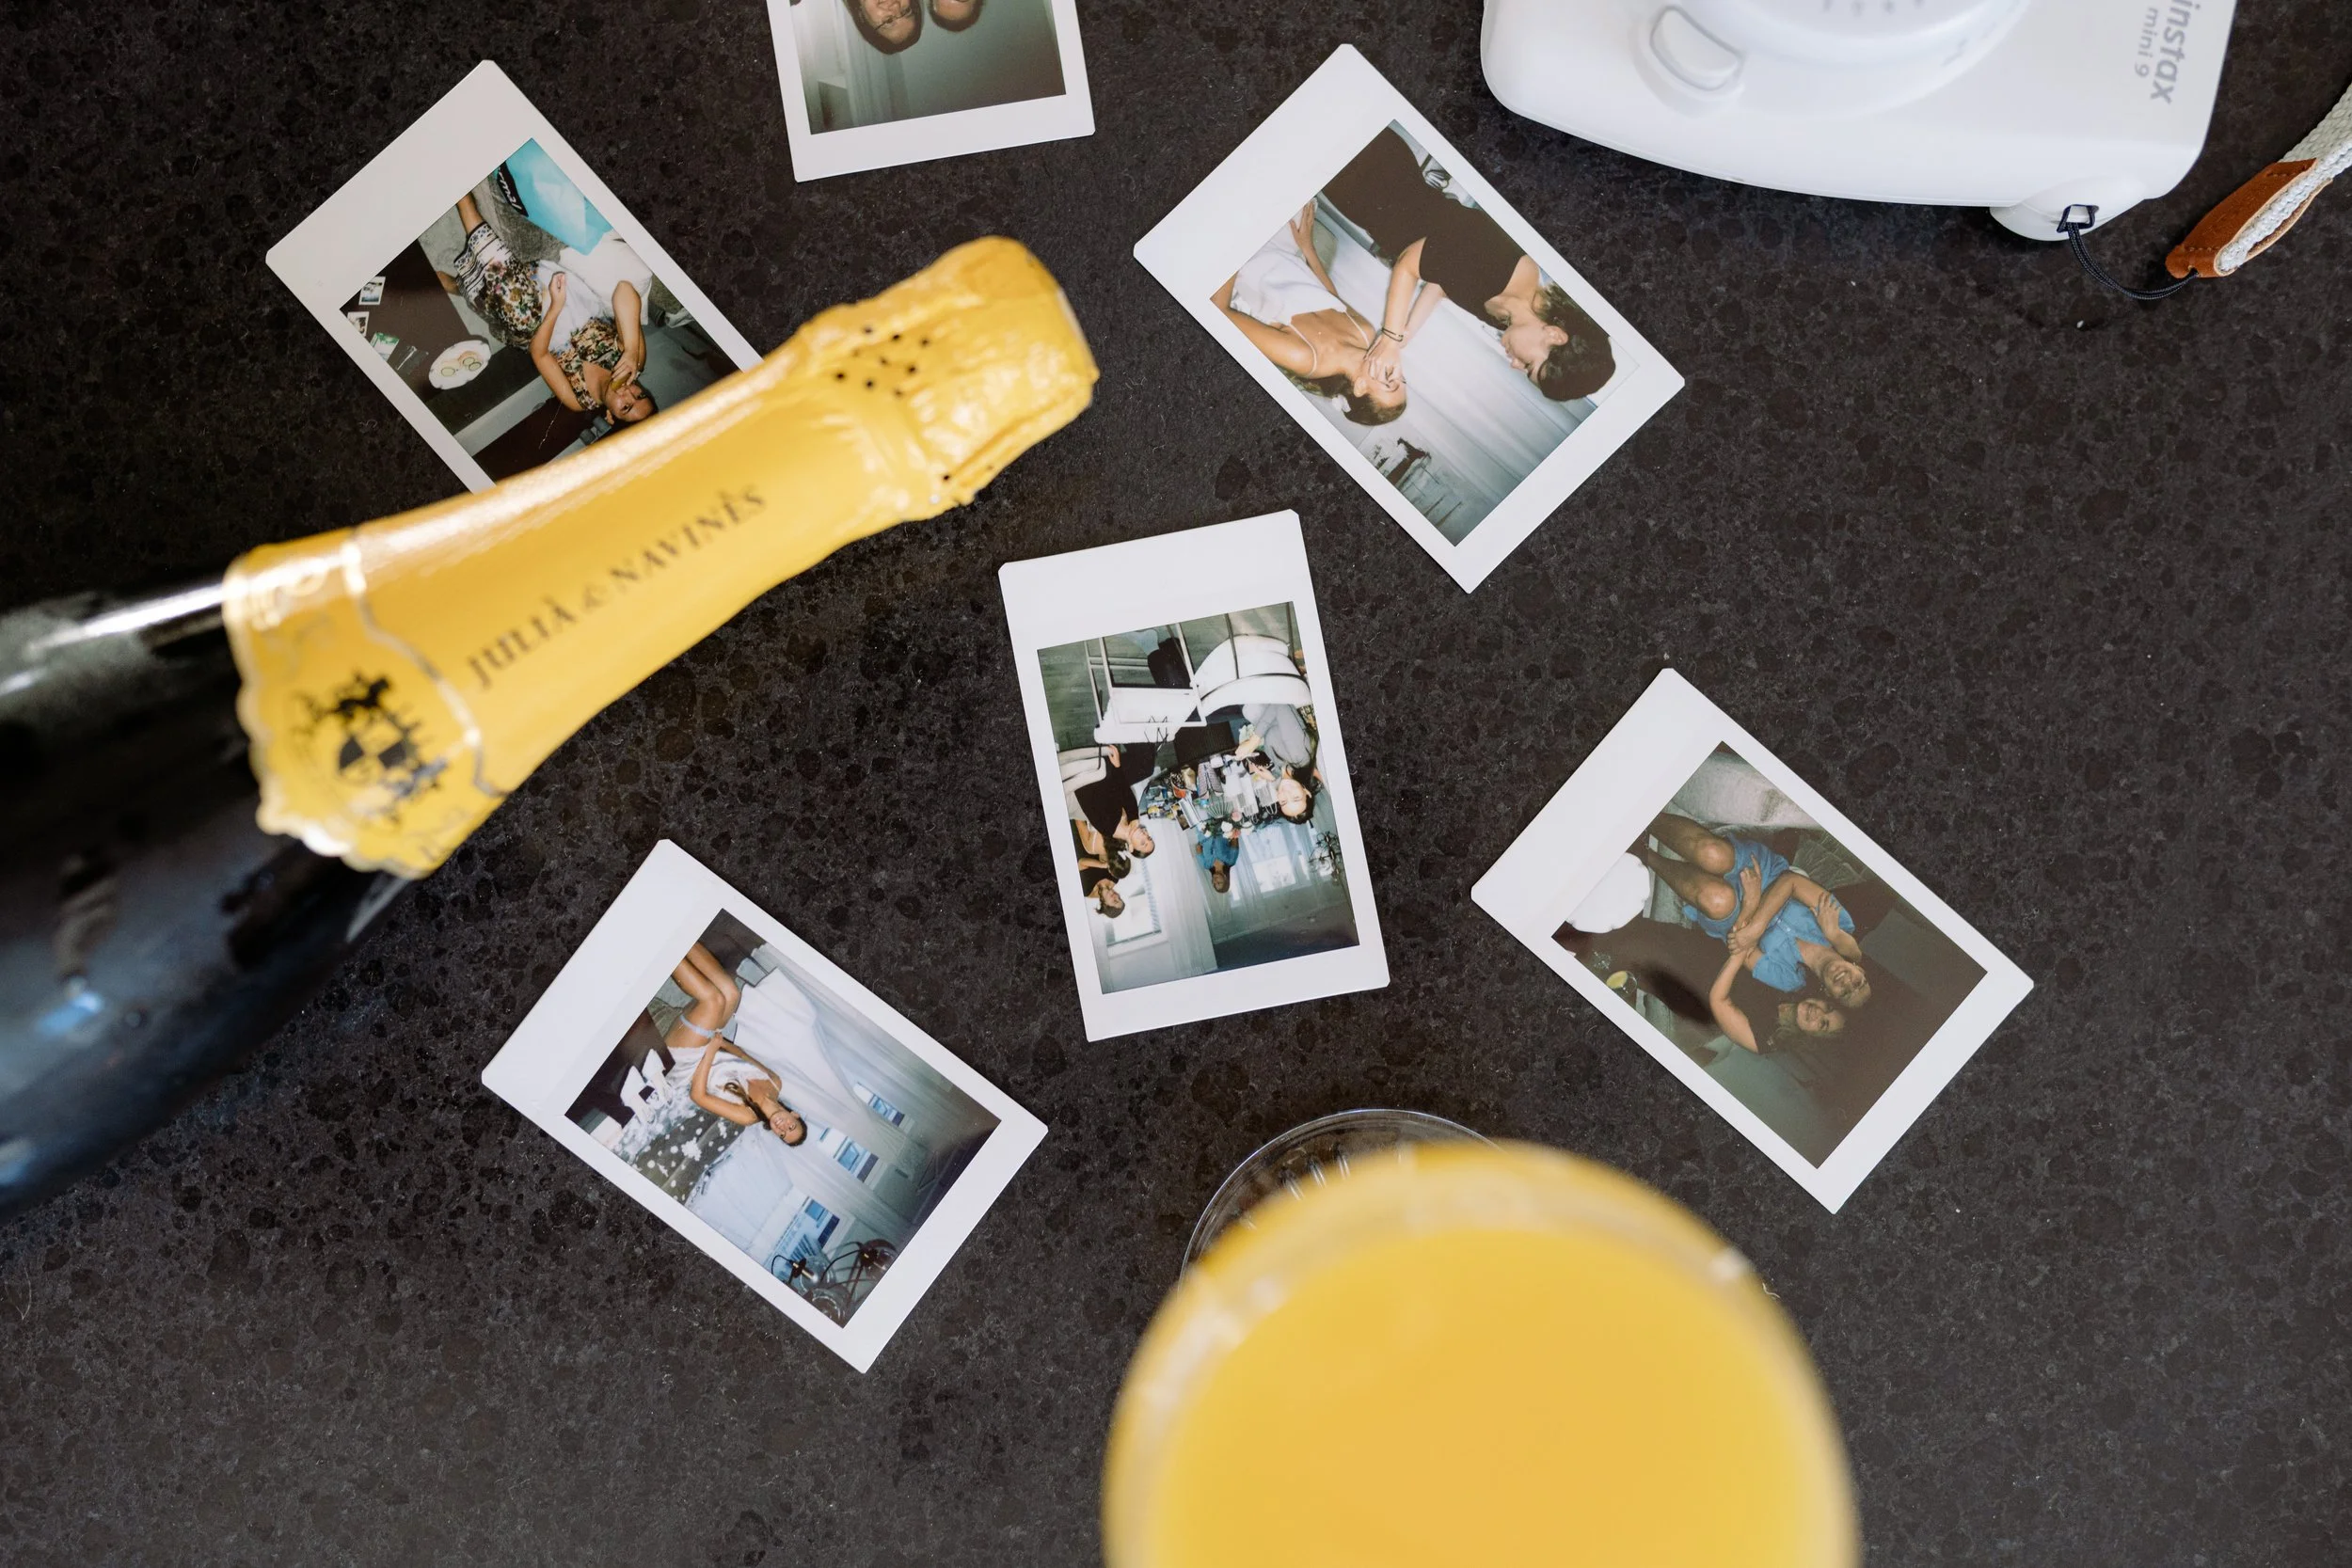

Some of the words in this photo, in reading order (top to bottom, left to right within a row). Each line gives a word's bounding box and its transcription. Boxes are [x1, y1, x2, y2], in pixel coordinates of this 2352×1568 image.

[2137, 7, 2158, 58] mini
[2150, 0, 2201, 104] instax
[2134, 63, 2150, 78] 9
[467, 594, 578, 689] JULIÀ
